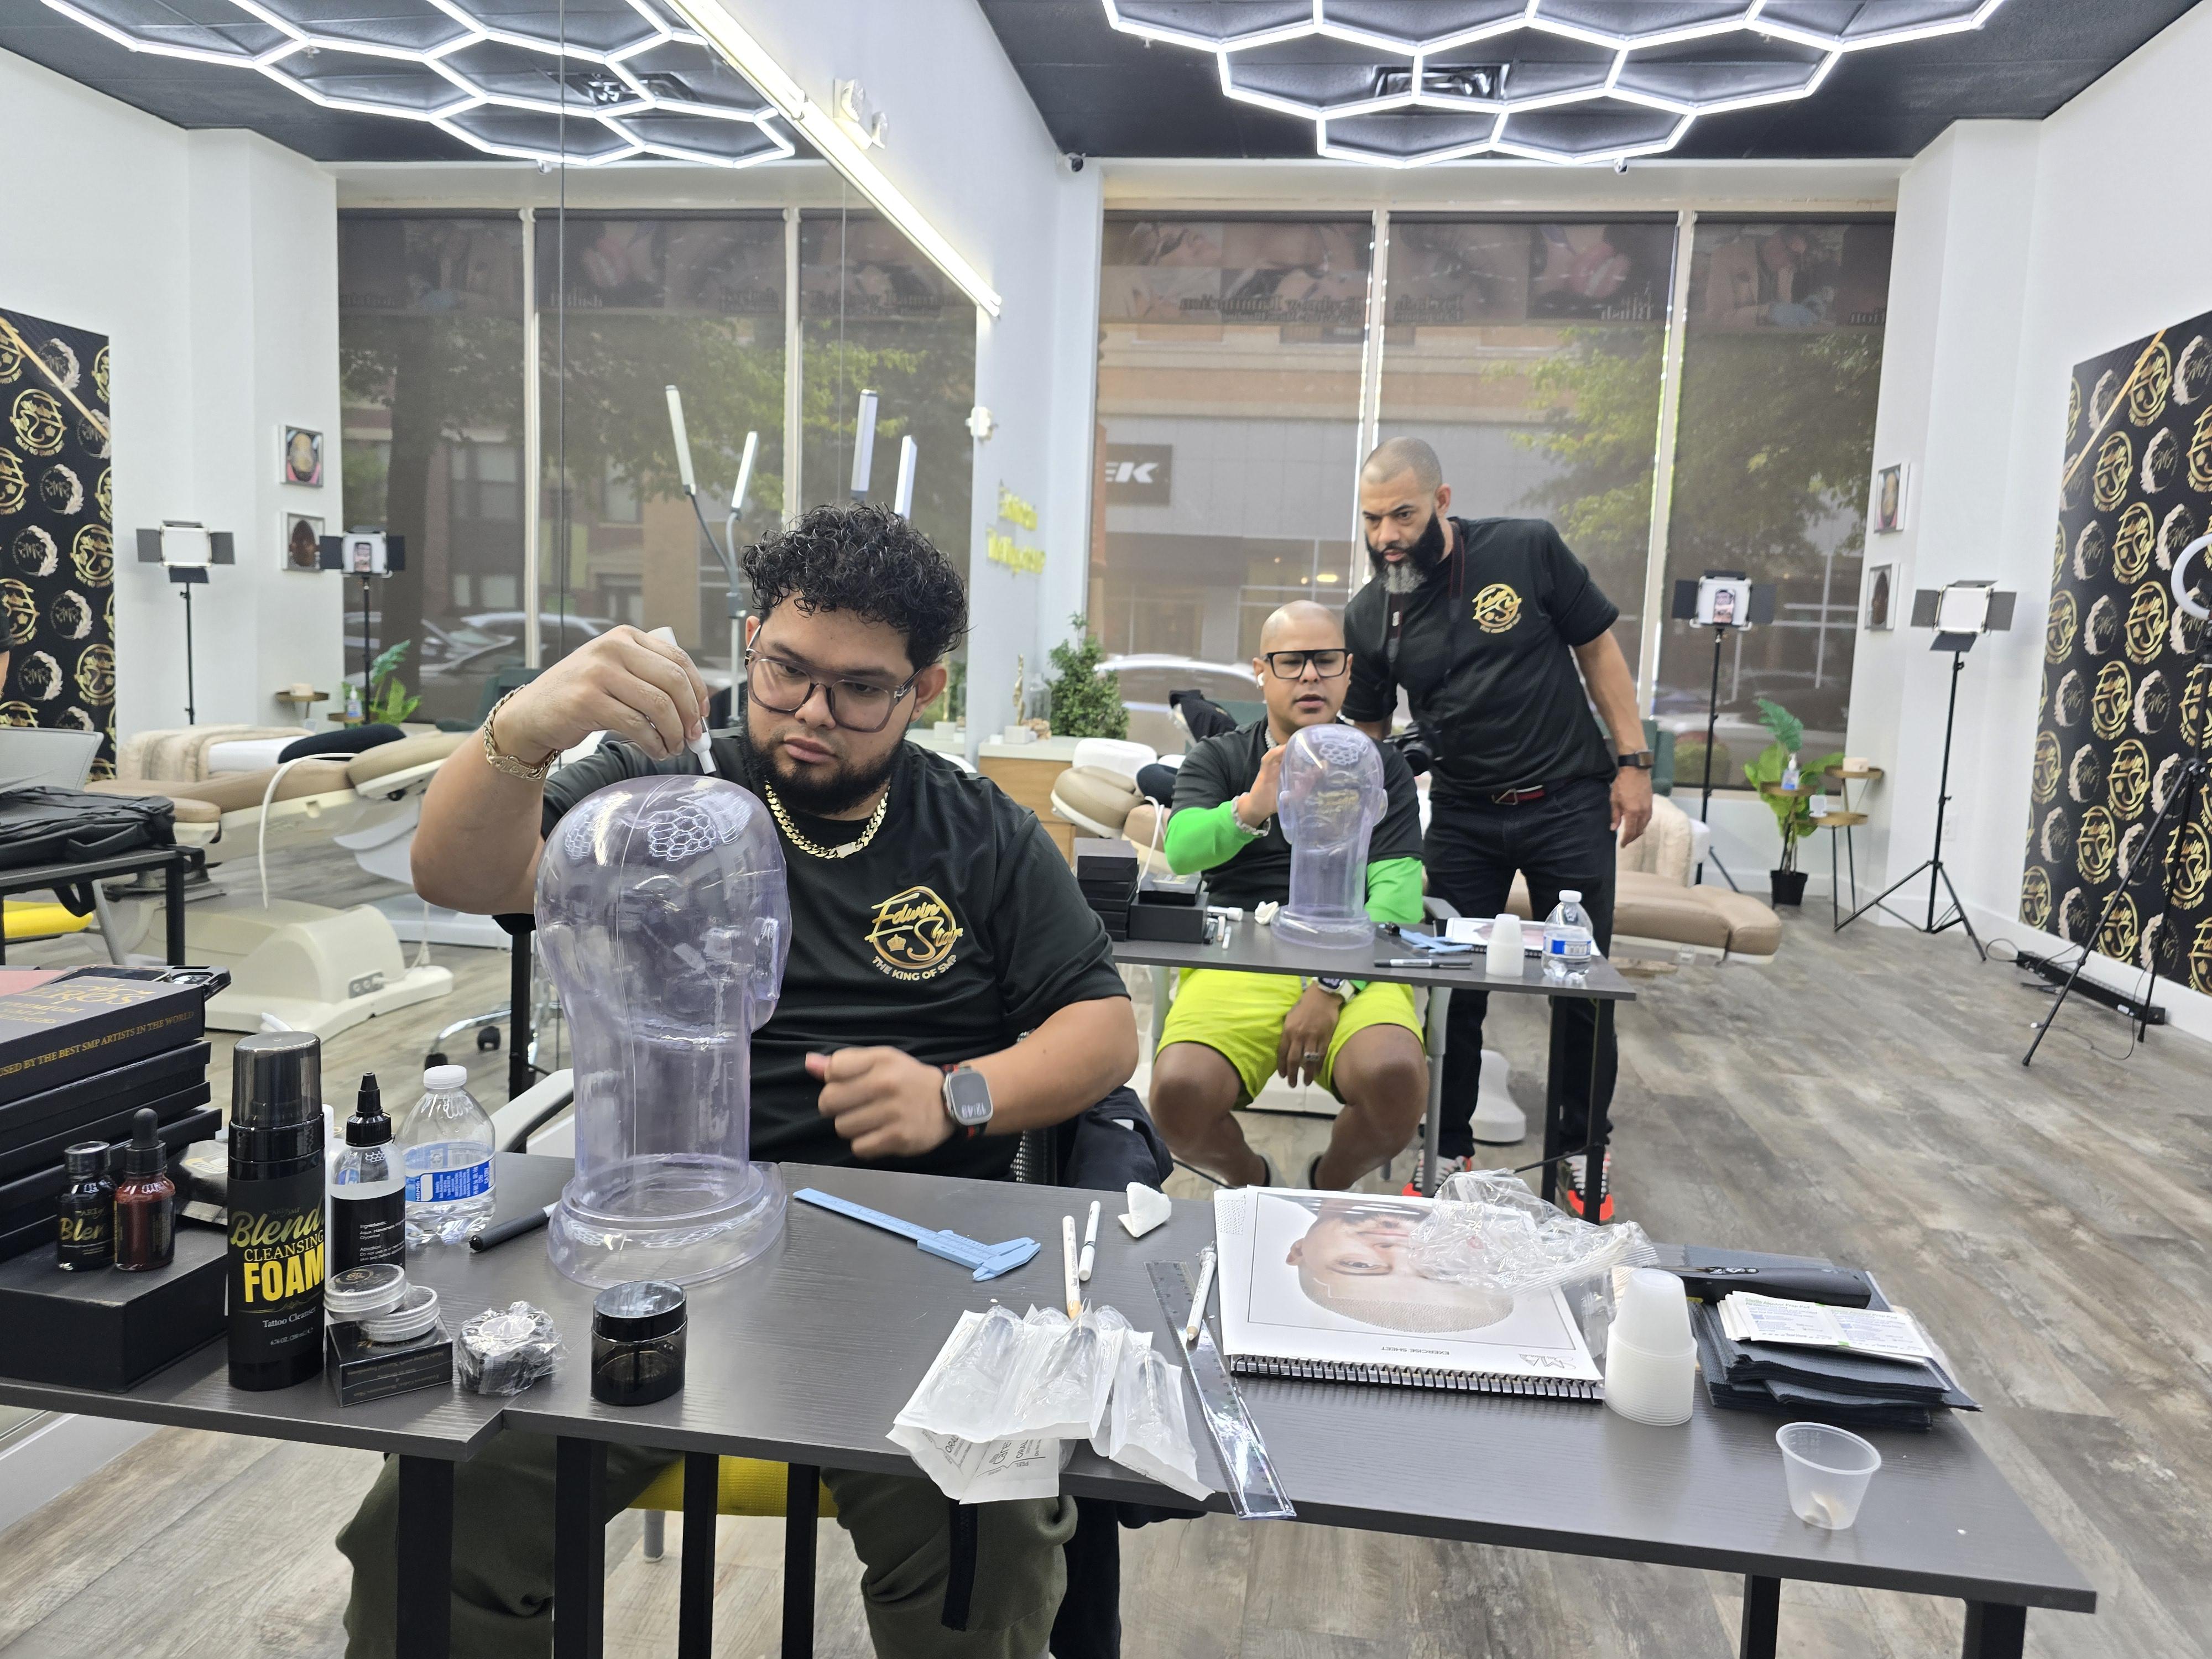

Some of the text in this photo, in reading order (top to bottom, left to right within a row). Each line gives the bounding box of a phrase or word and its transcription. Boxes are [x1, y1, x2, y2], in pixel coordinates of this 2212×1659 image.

[864, 892, 942, 943] Edwin
[872, 954, 957, 982] THE KING OF SMP
[23, 1059, 35, 1070] BY
[38, 1051, 58, 1065] THE
[59, 1044, 81, 1059] BEST
[82, 1038, 100, 1051] SMP
[101, 1027, 135, 1046] ARTISTS
[135, 1025, 146, 1035] IN
[147, 1020, 164, 1031] THE
[165, 1010, 194, 1026] WORLD
[244, 1229, 324, 1262] CLEANSING
[243, 1241, 325, 1302] FOAM
[262, 1306, 317, 1328] Tattoo Cleanser
[945, 1435, 959, 1453] ORAL
[993, 1440, 1012, 1464] Care
[1015, 1439, 1029, 1458] ORAL
